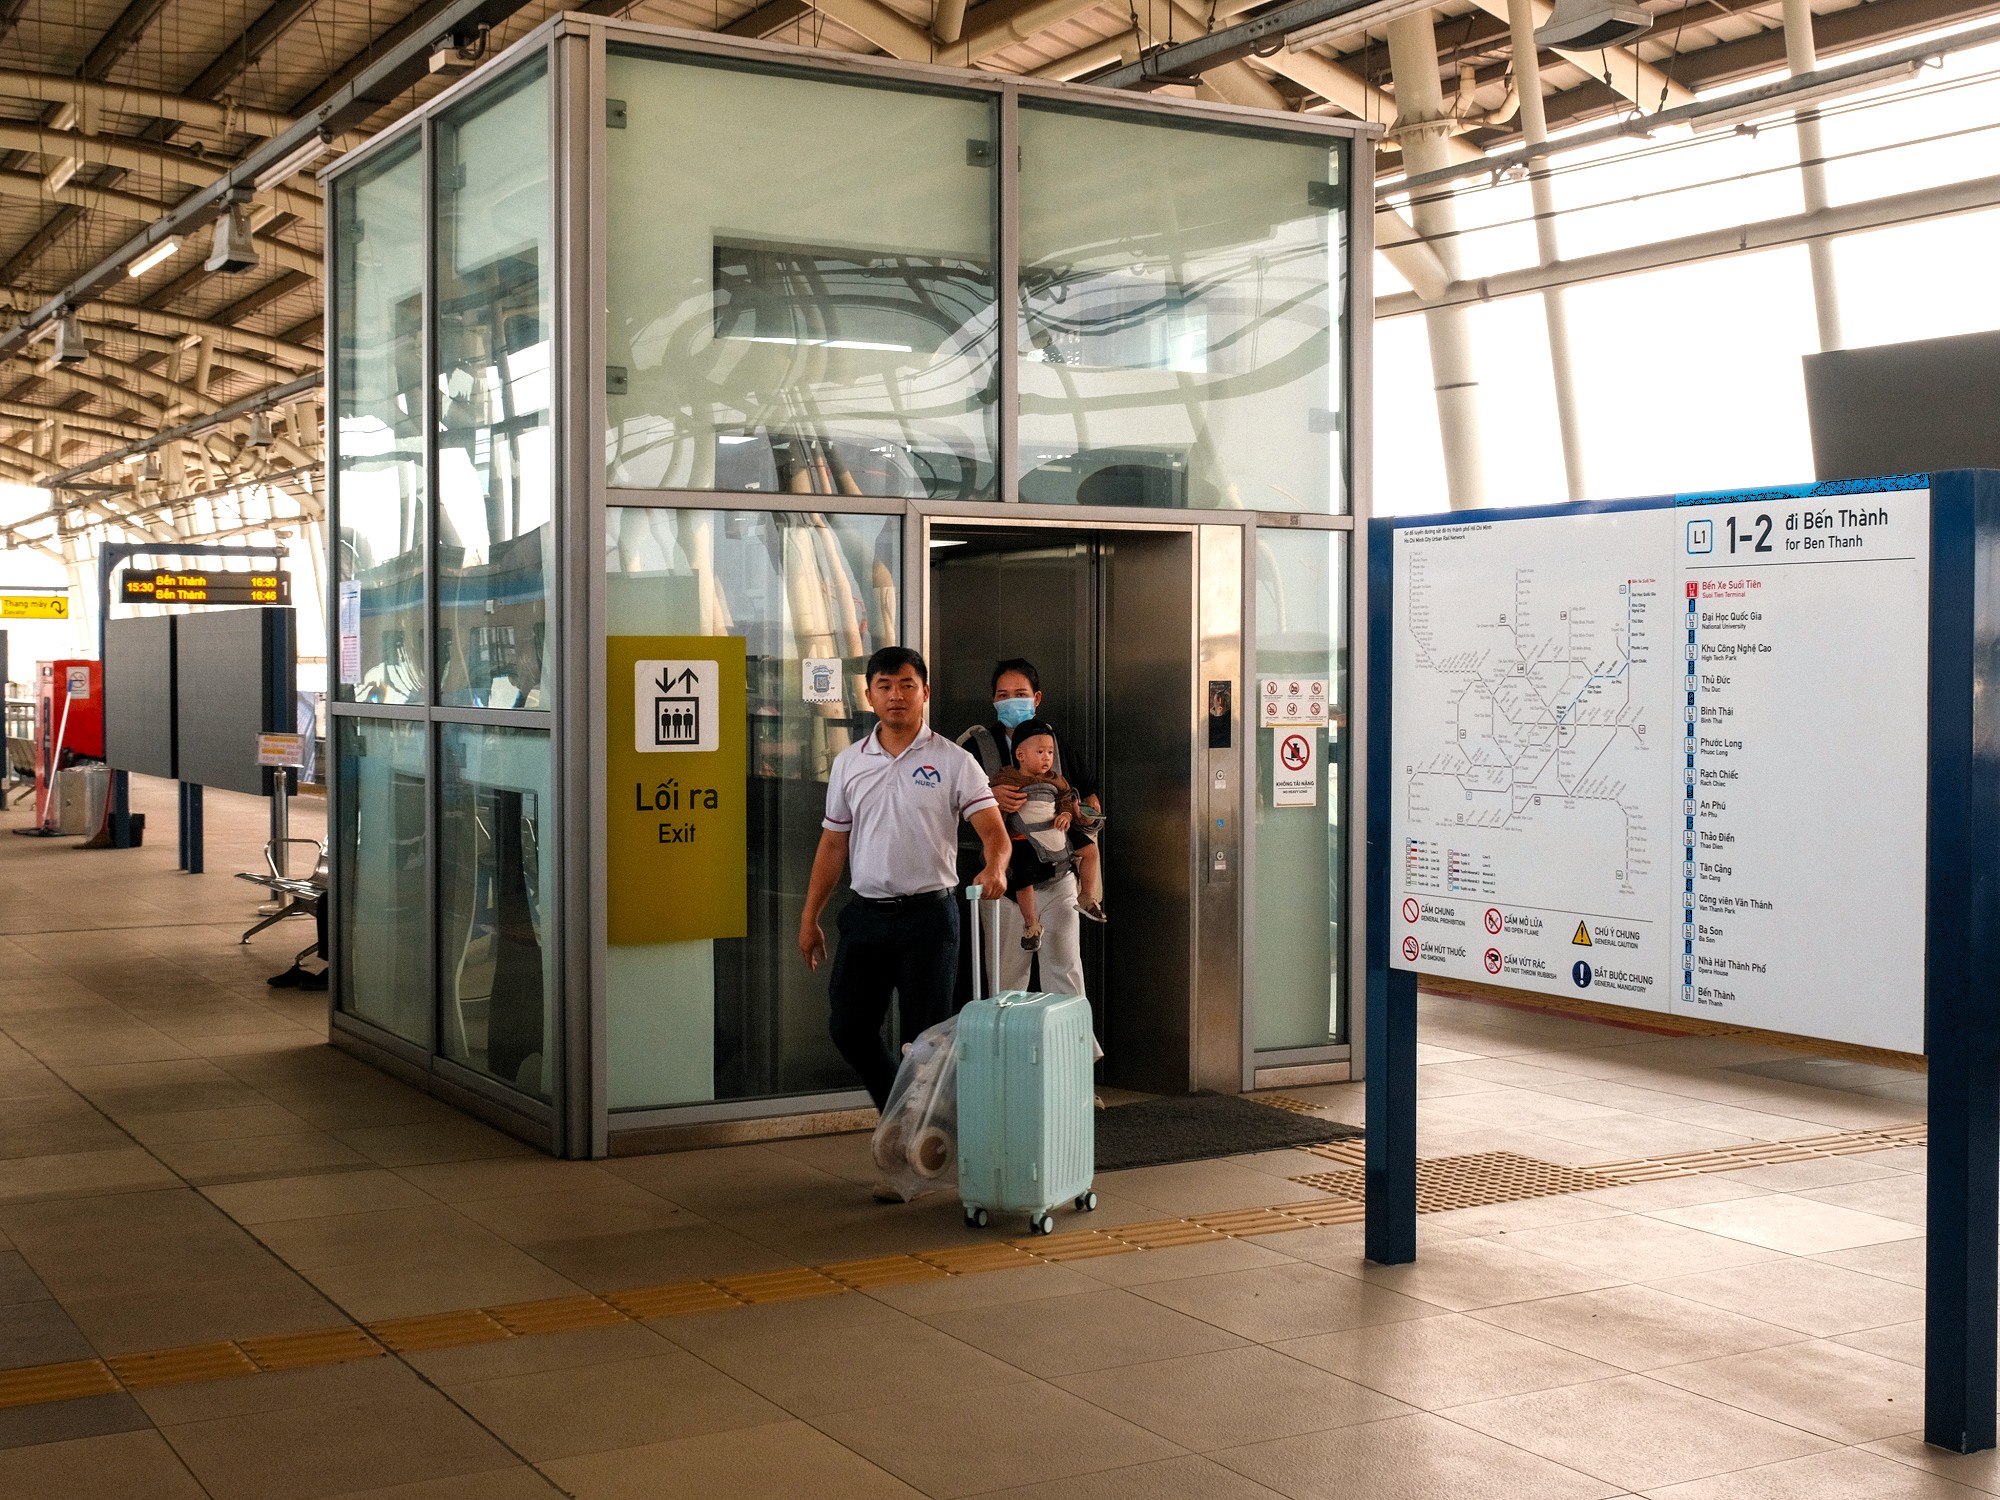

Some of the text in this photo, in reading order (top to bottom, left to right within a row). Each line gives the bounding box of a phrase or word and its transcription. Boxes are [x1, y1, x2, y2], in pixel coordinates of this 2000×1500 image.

[1786, 508, 1888, 530] đi Bến Thành
[1694, 530, 1706, 544] L1
[1726, 514, 1772, 553] 1-2
[1786, 535, 1862, 550] for Ben Thanh
[156, 575, 206, 586] Bến Thành
[251, 578, 277, 586] 16:30
[1702, 580, 1715, 590] Bến
[1729, 580, 1744, 589] Suối
[1746, 580, 1761, 588] Tiên
[128, 582, 154, 592] 15:30
[282, 581, 287, 595] 1
[156, 589, 206, 599] Bến Thành
[251, 591, 276, 600] 16:46
[5, 600, 28, 609] Thang
[1703, 613, 1713, 623] Đại
[1716, 612, 1728, 623] Học
[1730, 611, 1748, 620] Quốc
[1718, 644, 1735, 654] Công
[1737, 644, 1756, 654] Nghệ
[1717, 675, 1730, 684] Đức
[1724, 739, 1742, 749] Long
[1719, 770, 1739, 779] Chiếc
[915, 780, 935, 788] HURC
[637, 778, 718, 811] Lối ra
[659, 823, 696, 843] Exit
[1714, 864, 1732, 875] Cảng
[1699, 894, 1716, 905] Công
[1718, 897, 1733, 905] viên
[1421, 903, 1454, 916] CẤM CHUNG
[1504, 913, 1517, 924] CẤM
[1519, 916, 1529, 926] MỞ
[1595, 926, 1640, 940] CHÚ Ý CHUNG
[1699, 925, 1723, 936] Ba Son
[1421, 941, 1433, 952] CẤM
[1434, 944, 1446, 954] HÚT
[1595, 938, 1638, 949] GENERAL CAUTION
[1504, 953, 1517, 965] CẤM
[1752, 964, 1766, 973] Phố
[1537, 971, 1557, 979] RUBBISH
[1609, 970, 1627, 982] BUỘC
[1629, 974, 1653, 985] CHUNG
[1594, 980, 1646, 993] GENERAL MANDATORY
[1698, 987, 1711, 996] Bến
